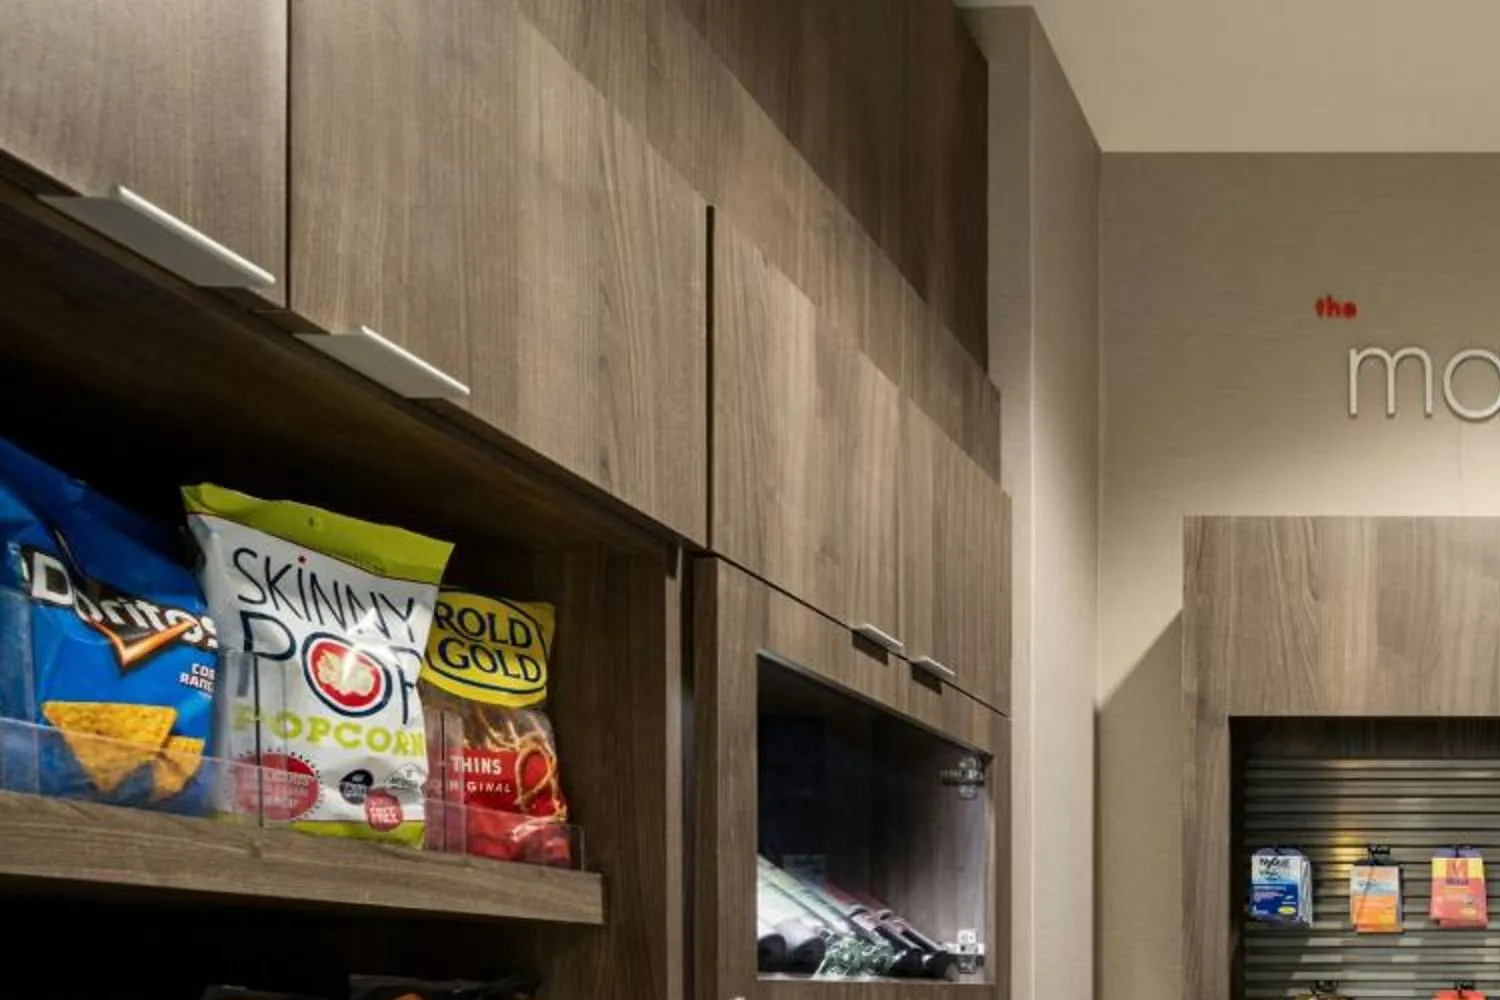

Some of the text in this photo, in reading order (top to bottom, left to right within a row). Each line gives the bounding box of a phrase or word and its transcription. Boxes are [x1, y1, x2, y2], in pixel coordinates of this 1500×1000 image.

[1315, 296, 1357, 319] the
[434, 601, 532, 648] ROLD
[438, 637, 541, 683] GOLD
[233, 705, 427, 758] POPCORN
[452, 756, 502, 775] THINS
